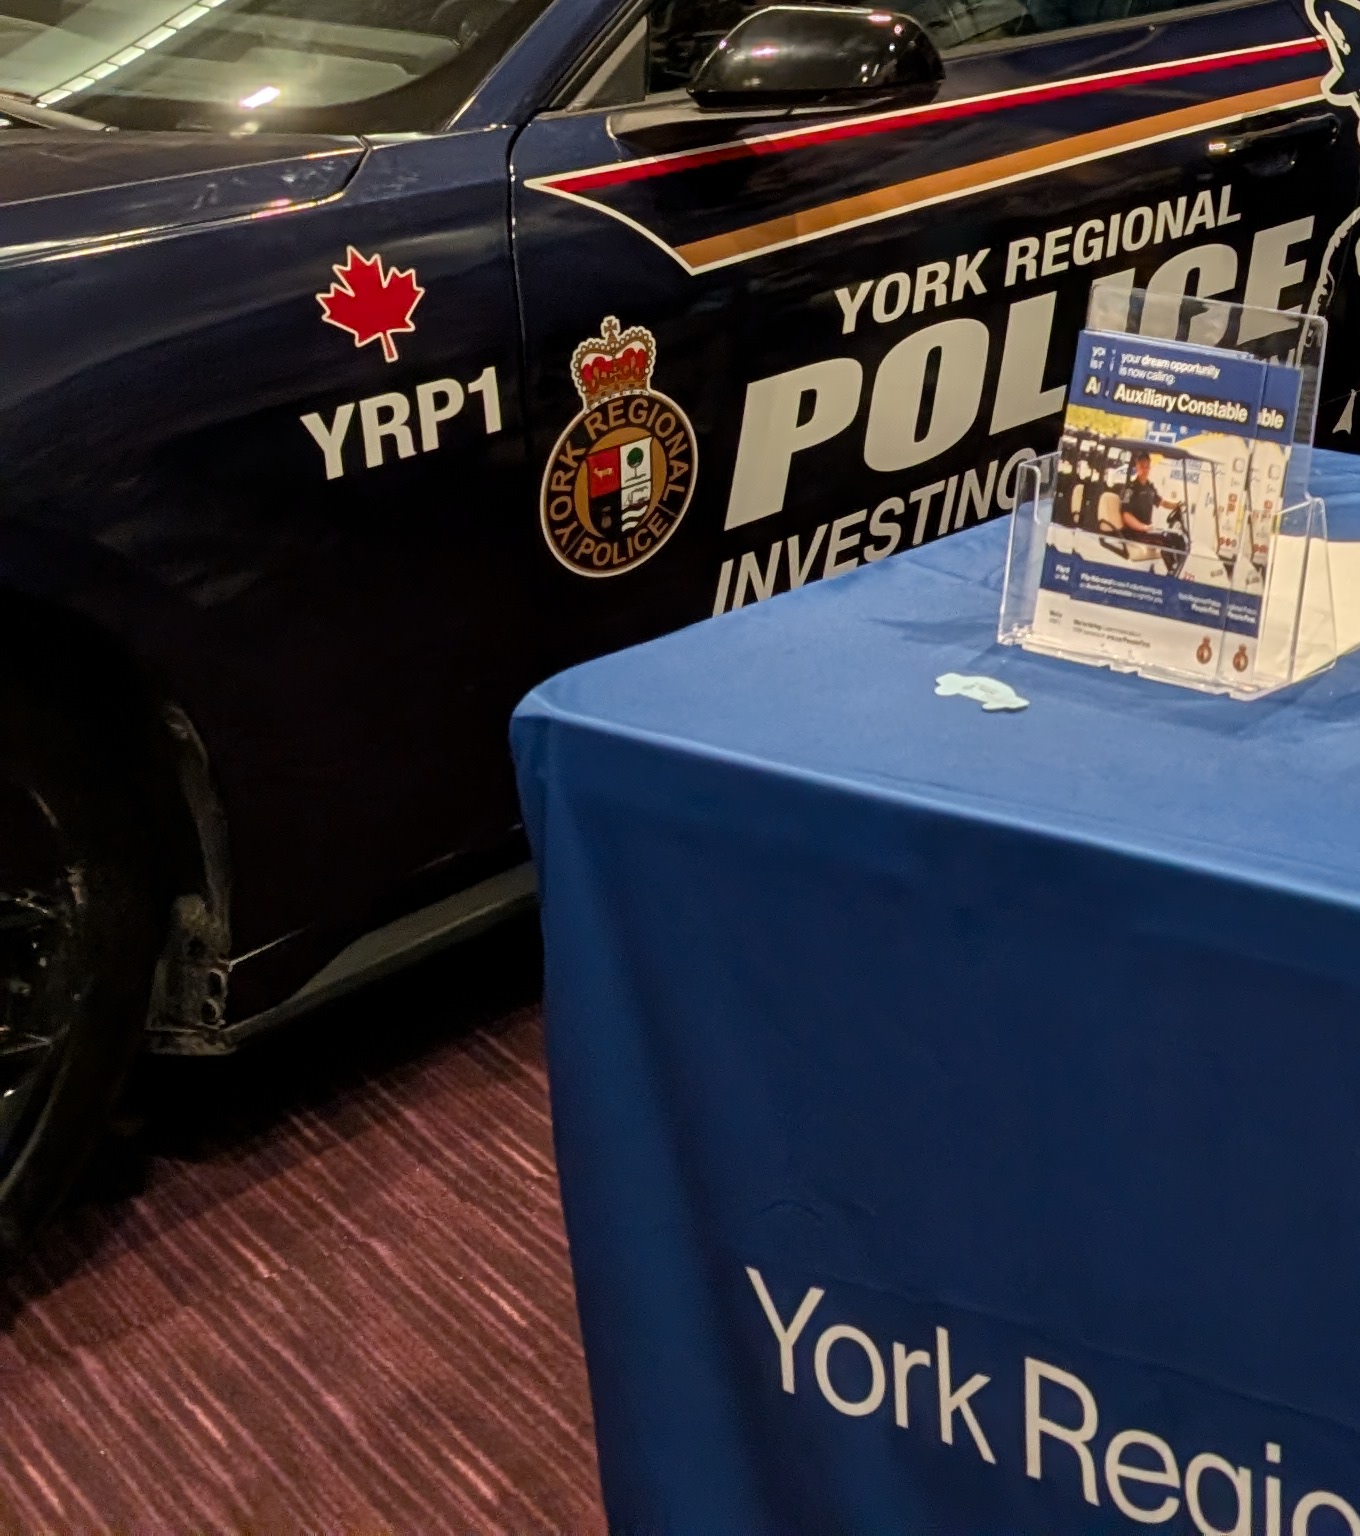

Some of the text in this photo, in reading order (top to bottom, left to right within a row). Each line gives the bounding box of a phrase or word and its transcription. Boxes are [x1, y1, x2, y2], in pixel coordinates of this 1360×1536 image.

[835, 184, 1241, 335] YORK REGIONAL
[1114, 383, 1177, 413] Auxiliary
[1177, 393, 1248, 424] Constable
[1121, 353, 1221, 380] your dream opportunity
[1128, 368, 1146, 379] now
[300, 366, 502, 481] YRP1
[549, 397, 690, 545] YORK REGIONAL
[575, 512, 669, 567] POLICE
[745, 1267, 996, 1464] York
